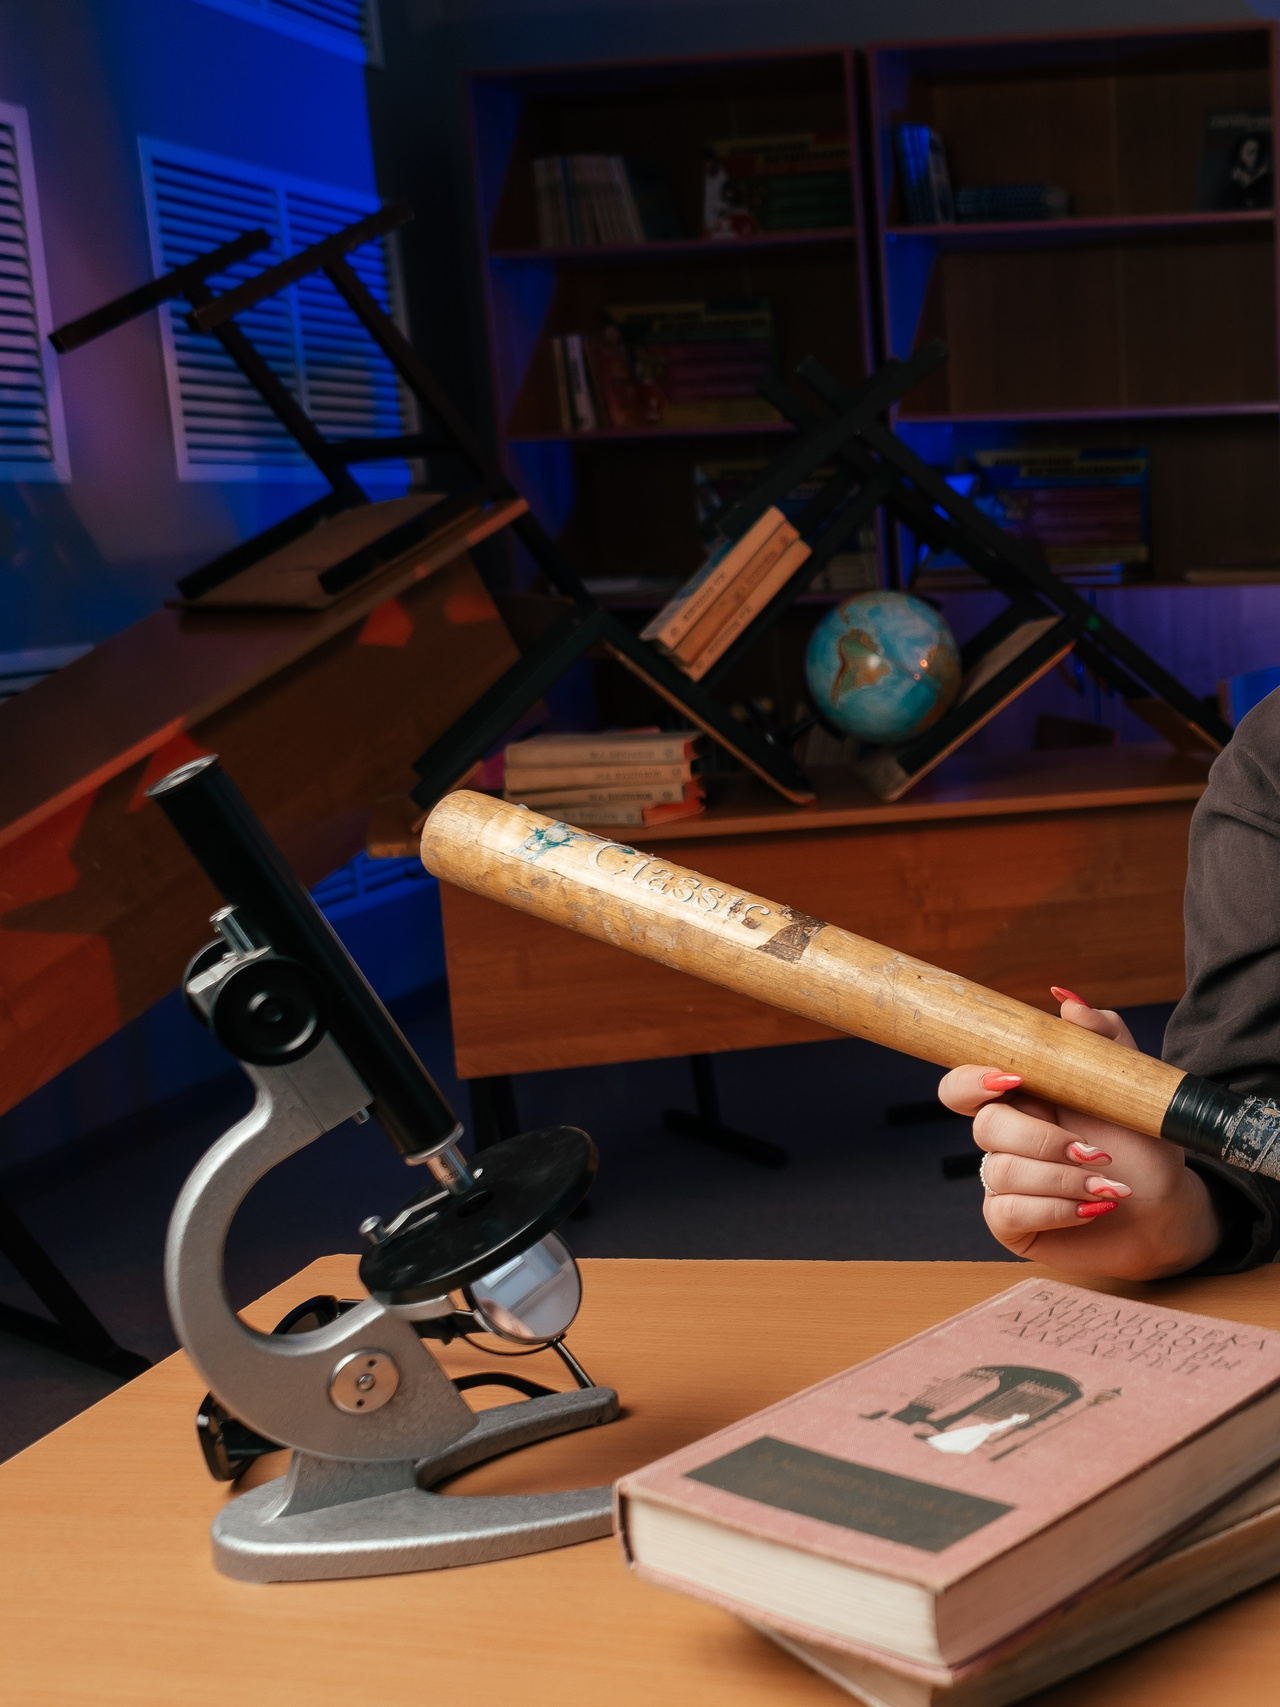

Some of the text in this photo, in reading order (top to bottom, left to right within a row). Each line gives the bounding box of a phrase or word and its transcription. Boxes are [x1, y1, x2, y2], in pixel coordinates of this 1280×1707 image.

[587, 841, 772, 930] Classic
[997, 1311, 1241, 1370] ЛИТЕРАТУРЫ
[1000, 1326, 1075, 1346] ДЛЯ
[1031, 1290, 1266, 1351] БИБЛИОТЕКА
